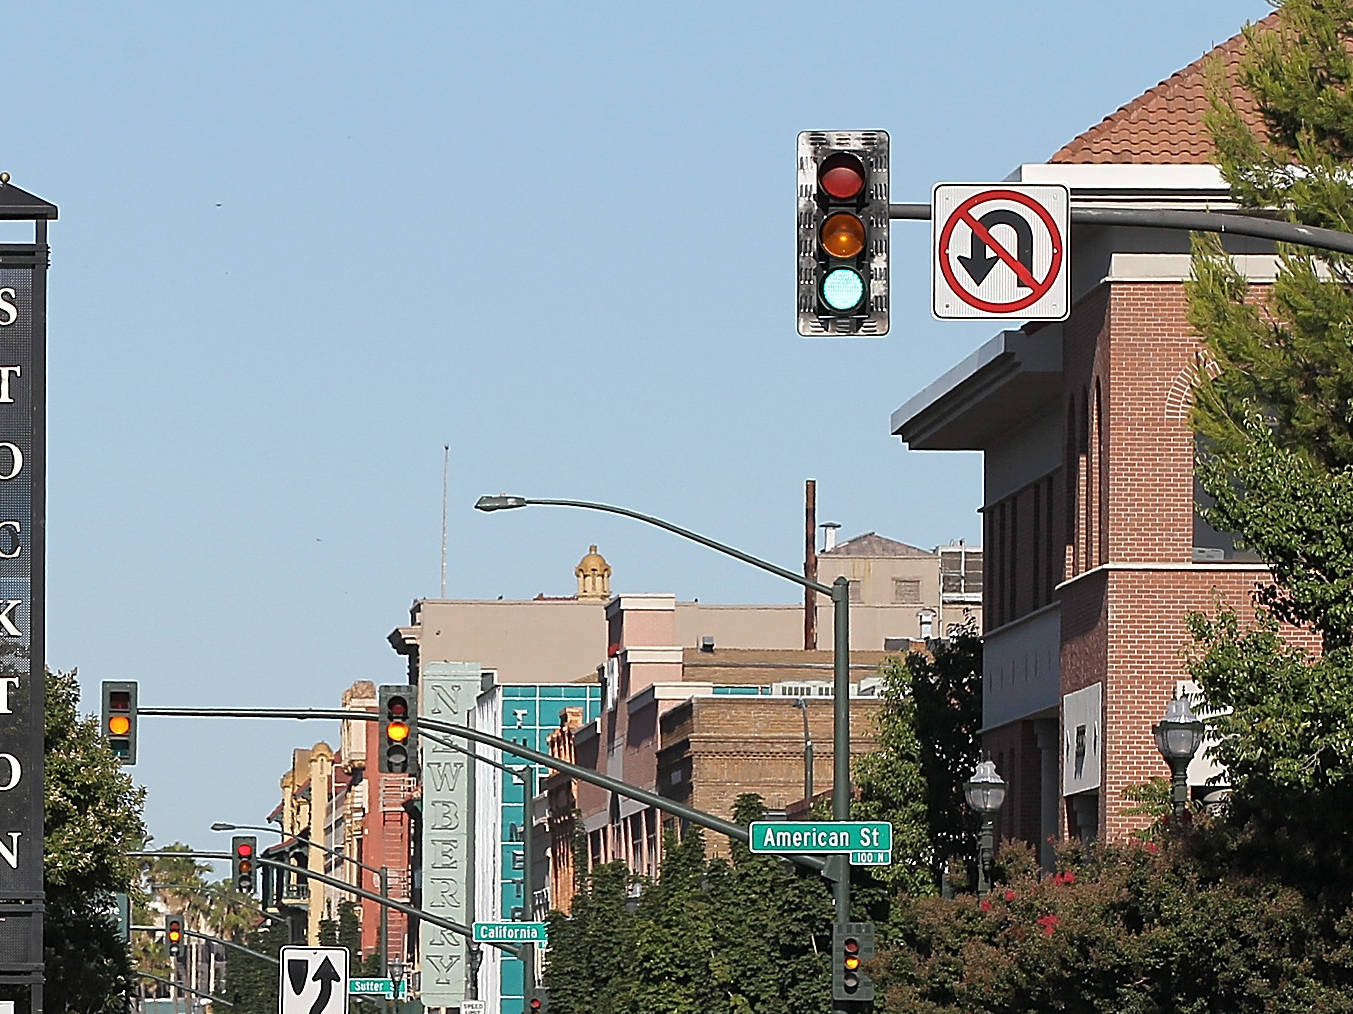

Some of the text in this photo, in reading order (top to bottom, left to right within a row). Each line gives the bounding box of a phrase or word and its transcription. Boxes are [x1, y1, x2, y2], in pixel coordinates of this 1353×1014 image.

[763, 827, 880, 847] American St
[857, 852, 873, 863] 100
[480, 925, 538, 939] California
[354, 981, 384, 992] Sutter
